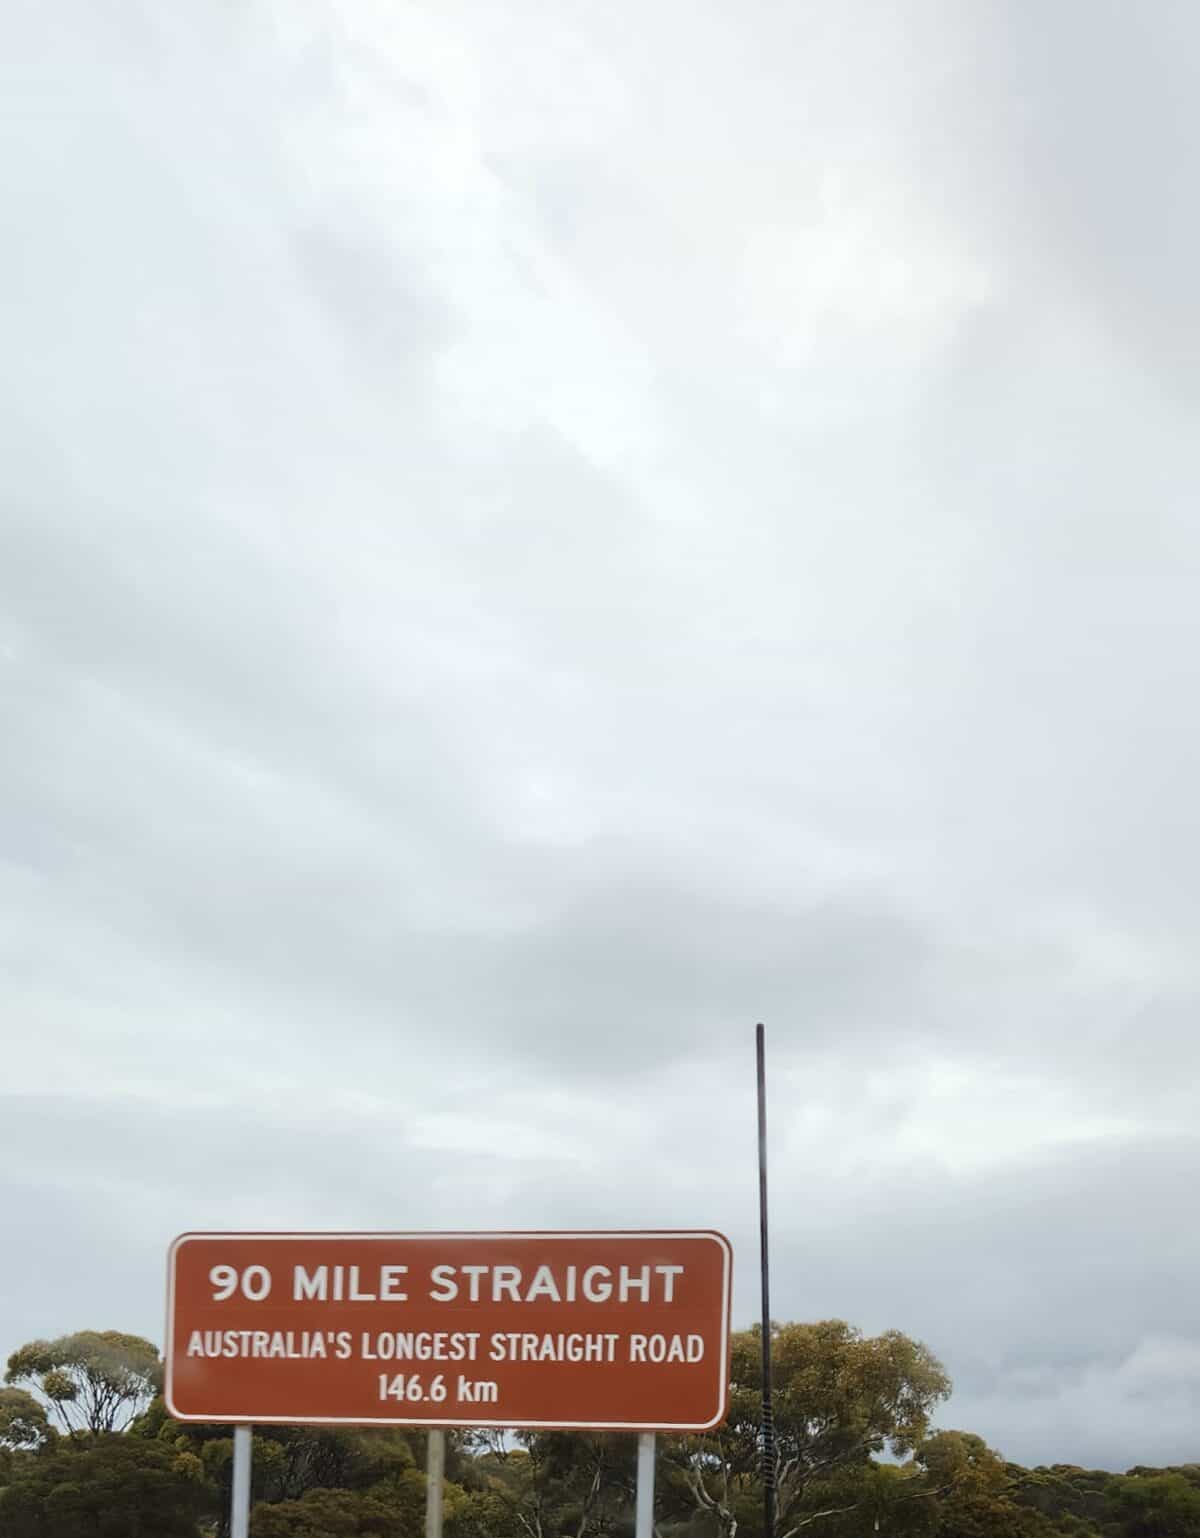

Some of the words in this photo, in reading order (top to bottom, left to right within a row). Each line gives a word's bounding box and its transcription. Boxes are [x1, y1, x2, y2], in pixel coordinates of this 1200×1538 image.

[209, 1264, 272, 1301] 90
[293, 1265, 408, 1302] MILE
[429, 1264, 684, 1303] STRAIGHT
[187, 1330, 352, 1359] AUSTRALIA'S
[361, 1332, 481, 1361] LONGEST
[489, 1333, 619, 1362] STRAIGHT
[630, 1334, 705, 1363] ROAD
[379, 1373, 447, 1402] 146.6
[457, 1374, 498, 1403] km
